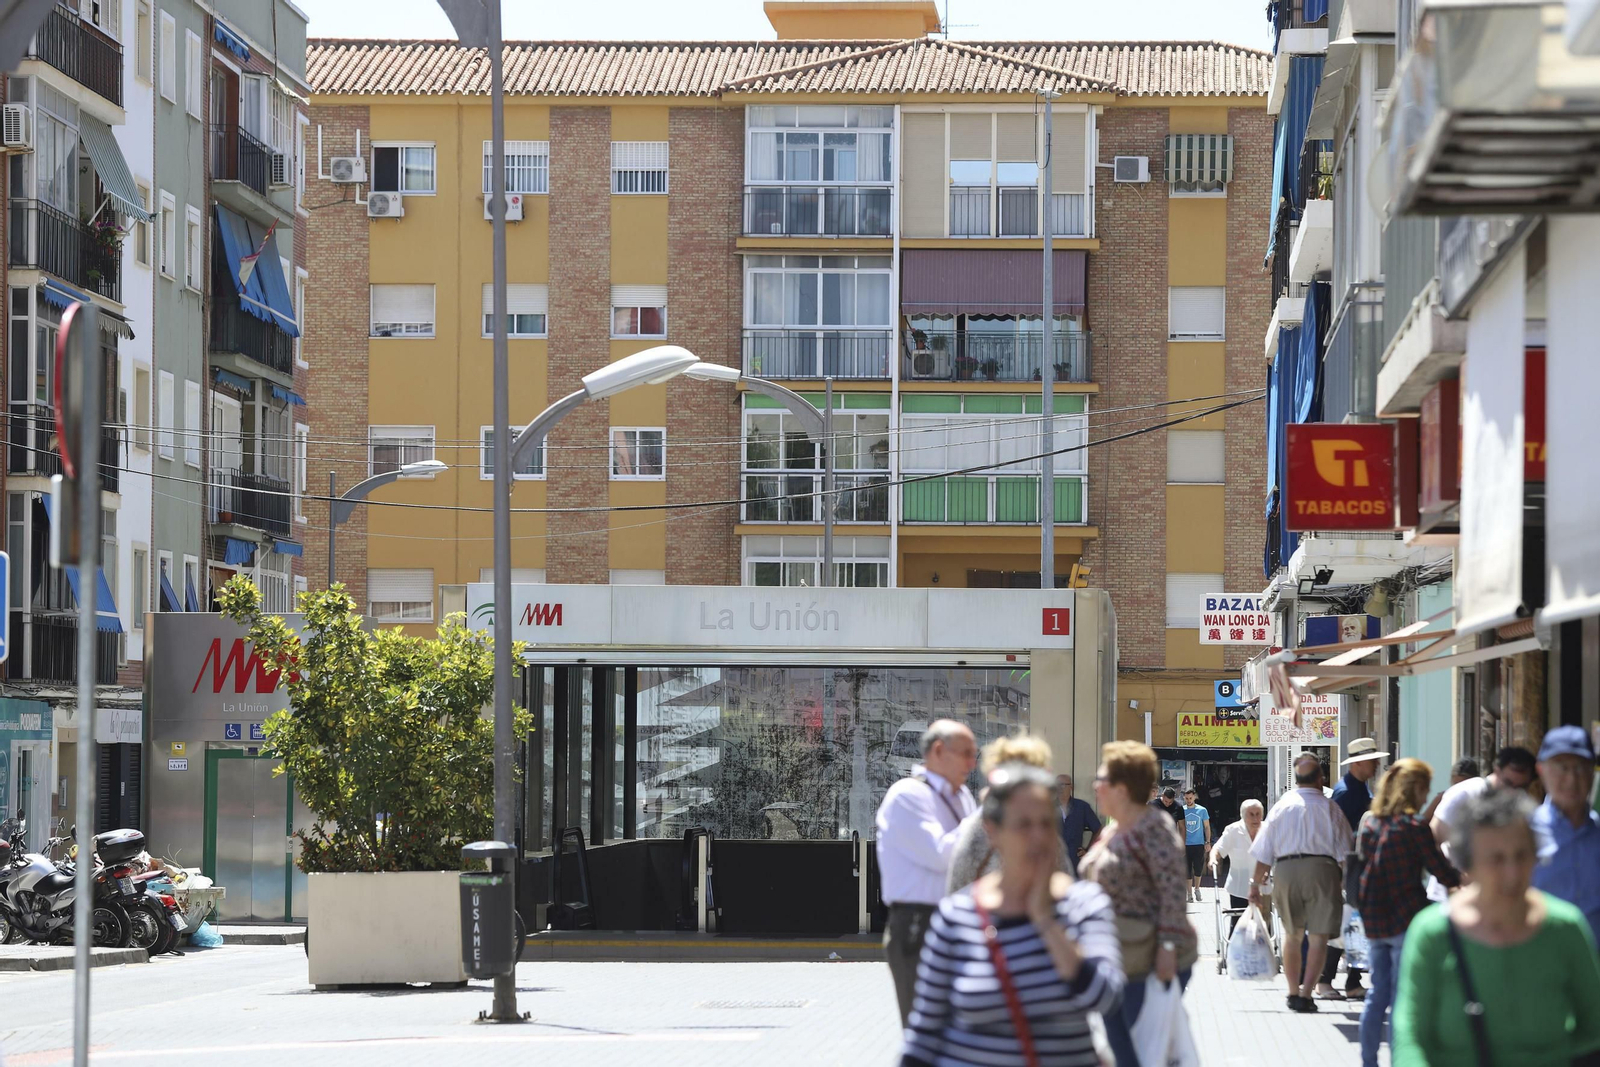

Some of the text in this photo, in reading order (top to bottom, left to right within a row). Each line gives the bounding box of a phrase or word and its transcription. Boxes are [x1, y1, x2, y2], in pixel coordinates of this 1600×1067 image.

[1295, 500, 1385, 515] TABACOS
[699, 601, 839, 630] La Unión
[1051, 613, 1060, 631] 1
[1203, 614, 1271, 626] WAN LONG DA
[1315, 694, 1328, 703] DE
[223, 702, 269, 712] La Unión
